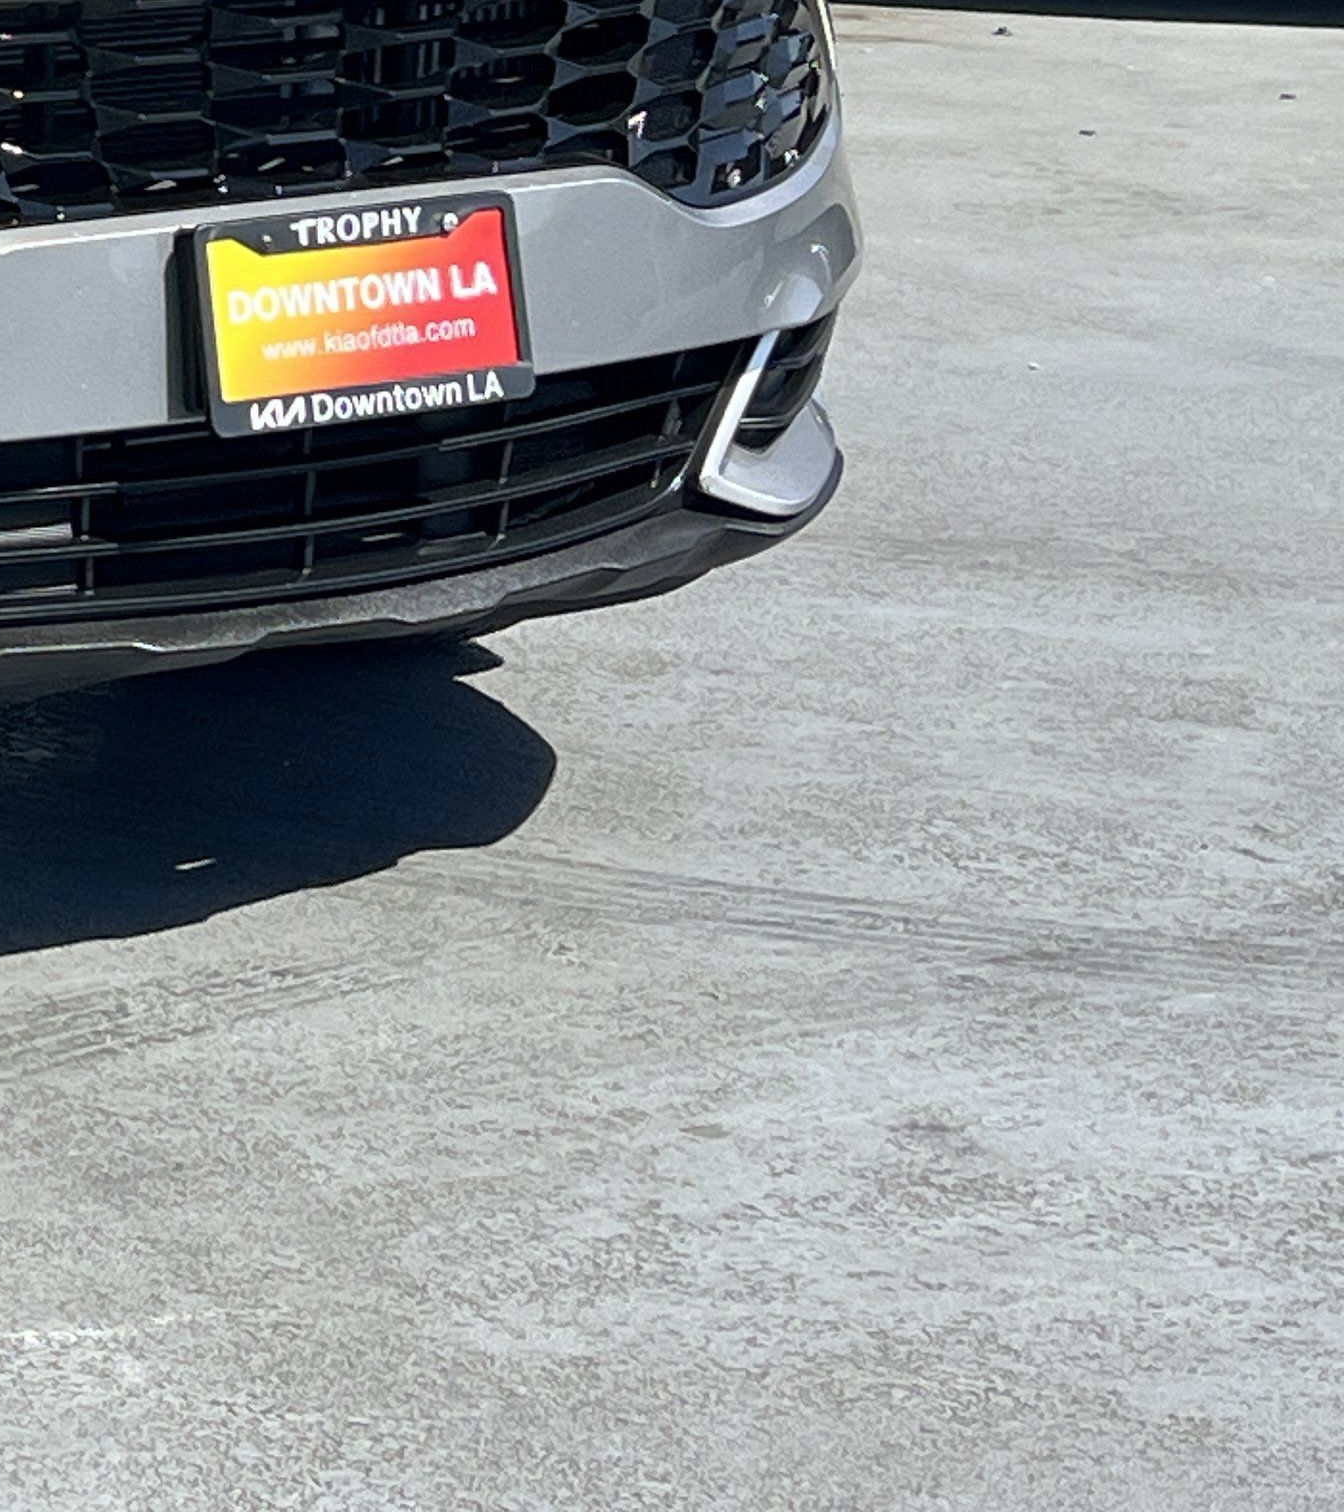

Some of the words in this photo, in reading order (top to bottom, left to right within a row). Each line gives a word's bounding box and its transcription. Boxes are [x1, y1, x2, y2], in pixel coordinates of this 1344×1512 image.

[289, 206, 423, 247] TROPHY
[227, 264, 441, 325] DOWNTOWN
[448, 260, 498, 299] LA
[312, 382, 463, 424] Downtown
[466, 370, 505, 402] LA
